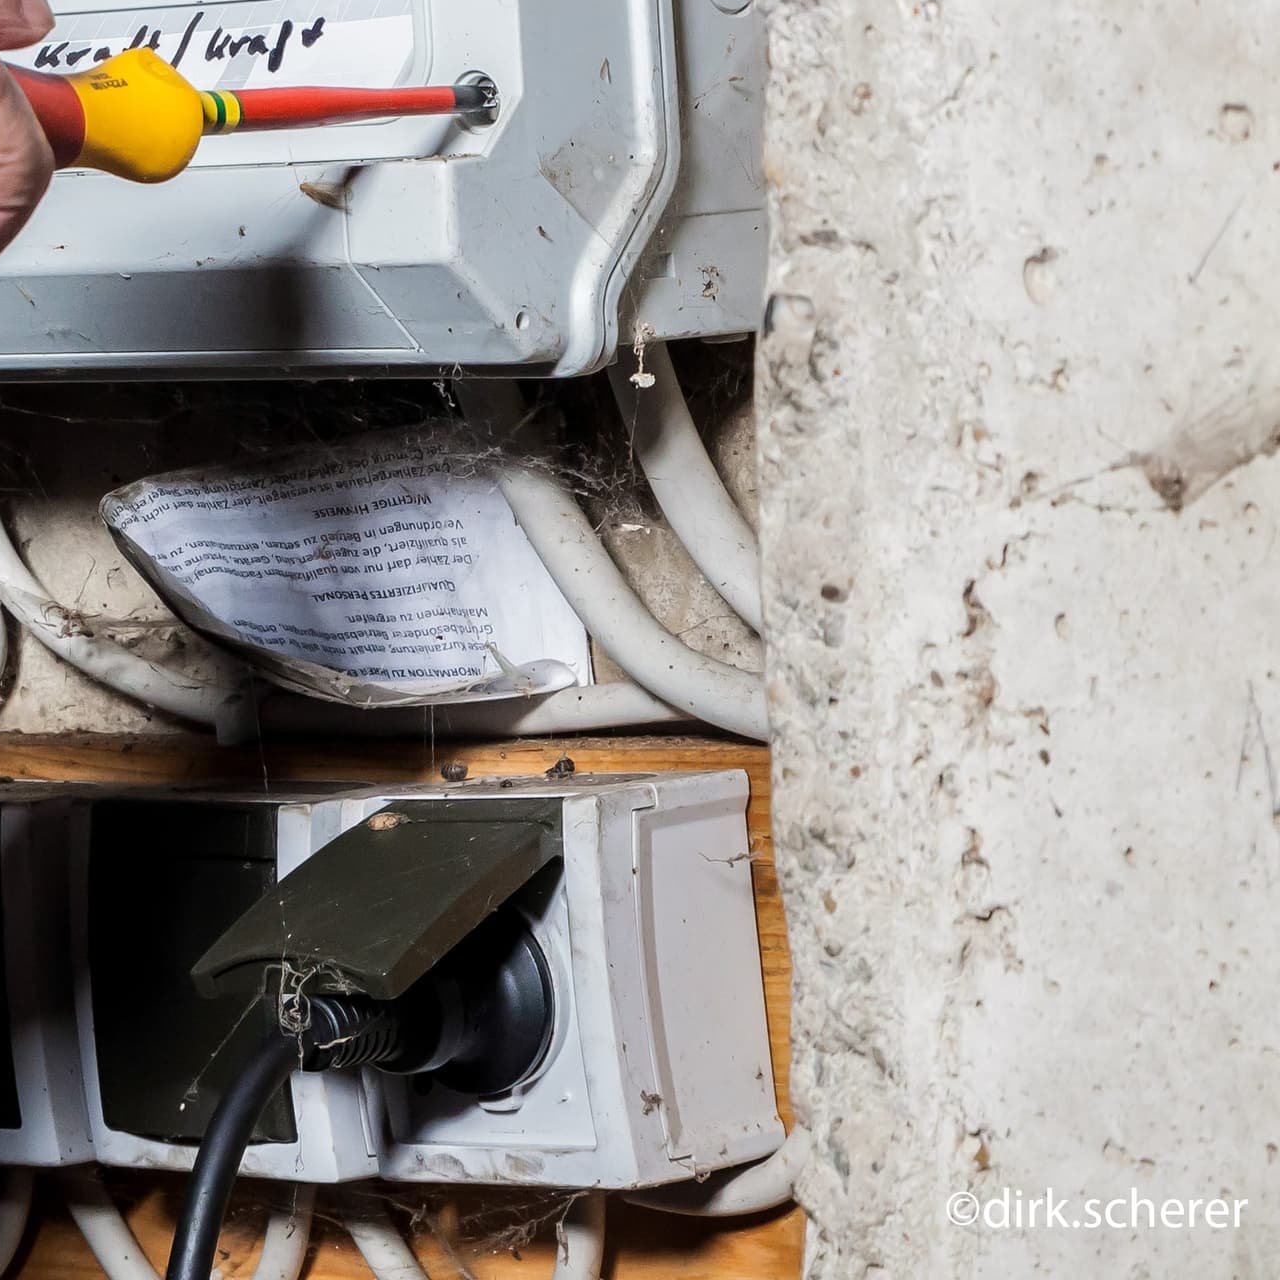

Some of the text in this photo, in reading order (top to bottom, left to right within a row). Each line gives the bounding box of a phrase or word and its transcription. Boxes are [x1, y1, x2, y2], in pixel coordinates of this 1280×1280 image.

[142, 503, 170, 523] nicht
[364, 529, 376, 539] in
[303, 537, 316, 546] zu
[451, 537, 466, 548] als
[170, 547, 183, 558] zu
[362, 546, 381, 558] die
[364, 563, 383, 574] nur
[386, 558, 412, 572] darf
[312, 579, 455, 603] QUALIFIZIERTES PERSONAL
[408, 667, 480, 678] INFORMATION
